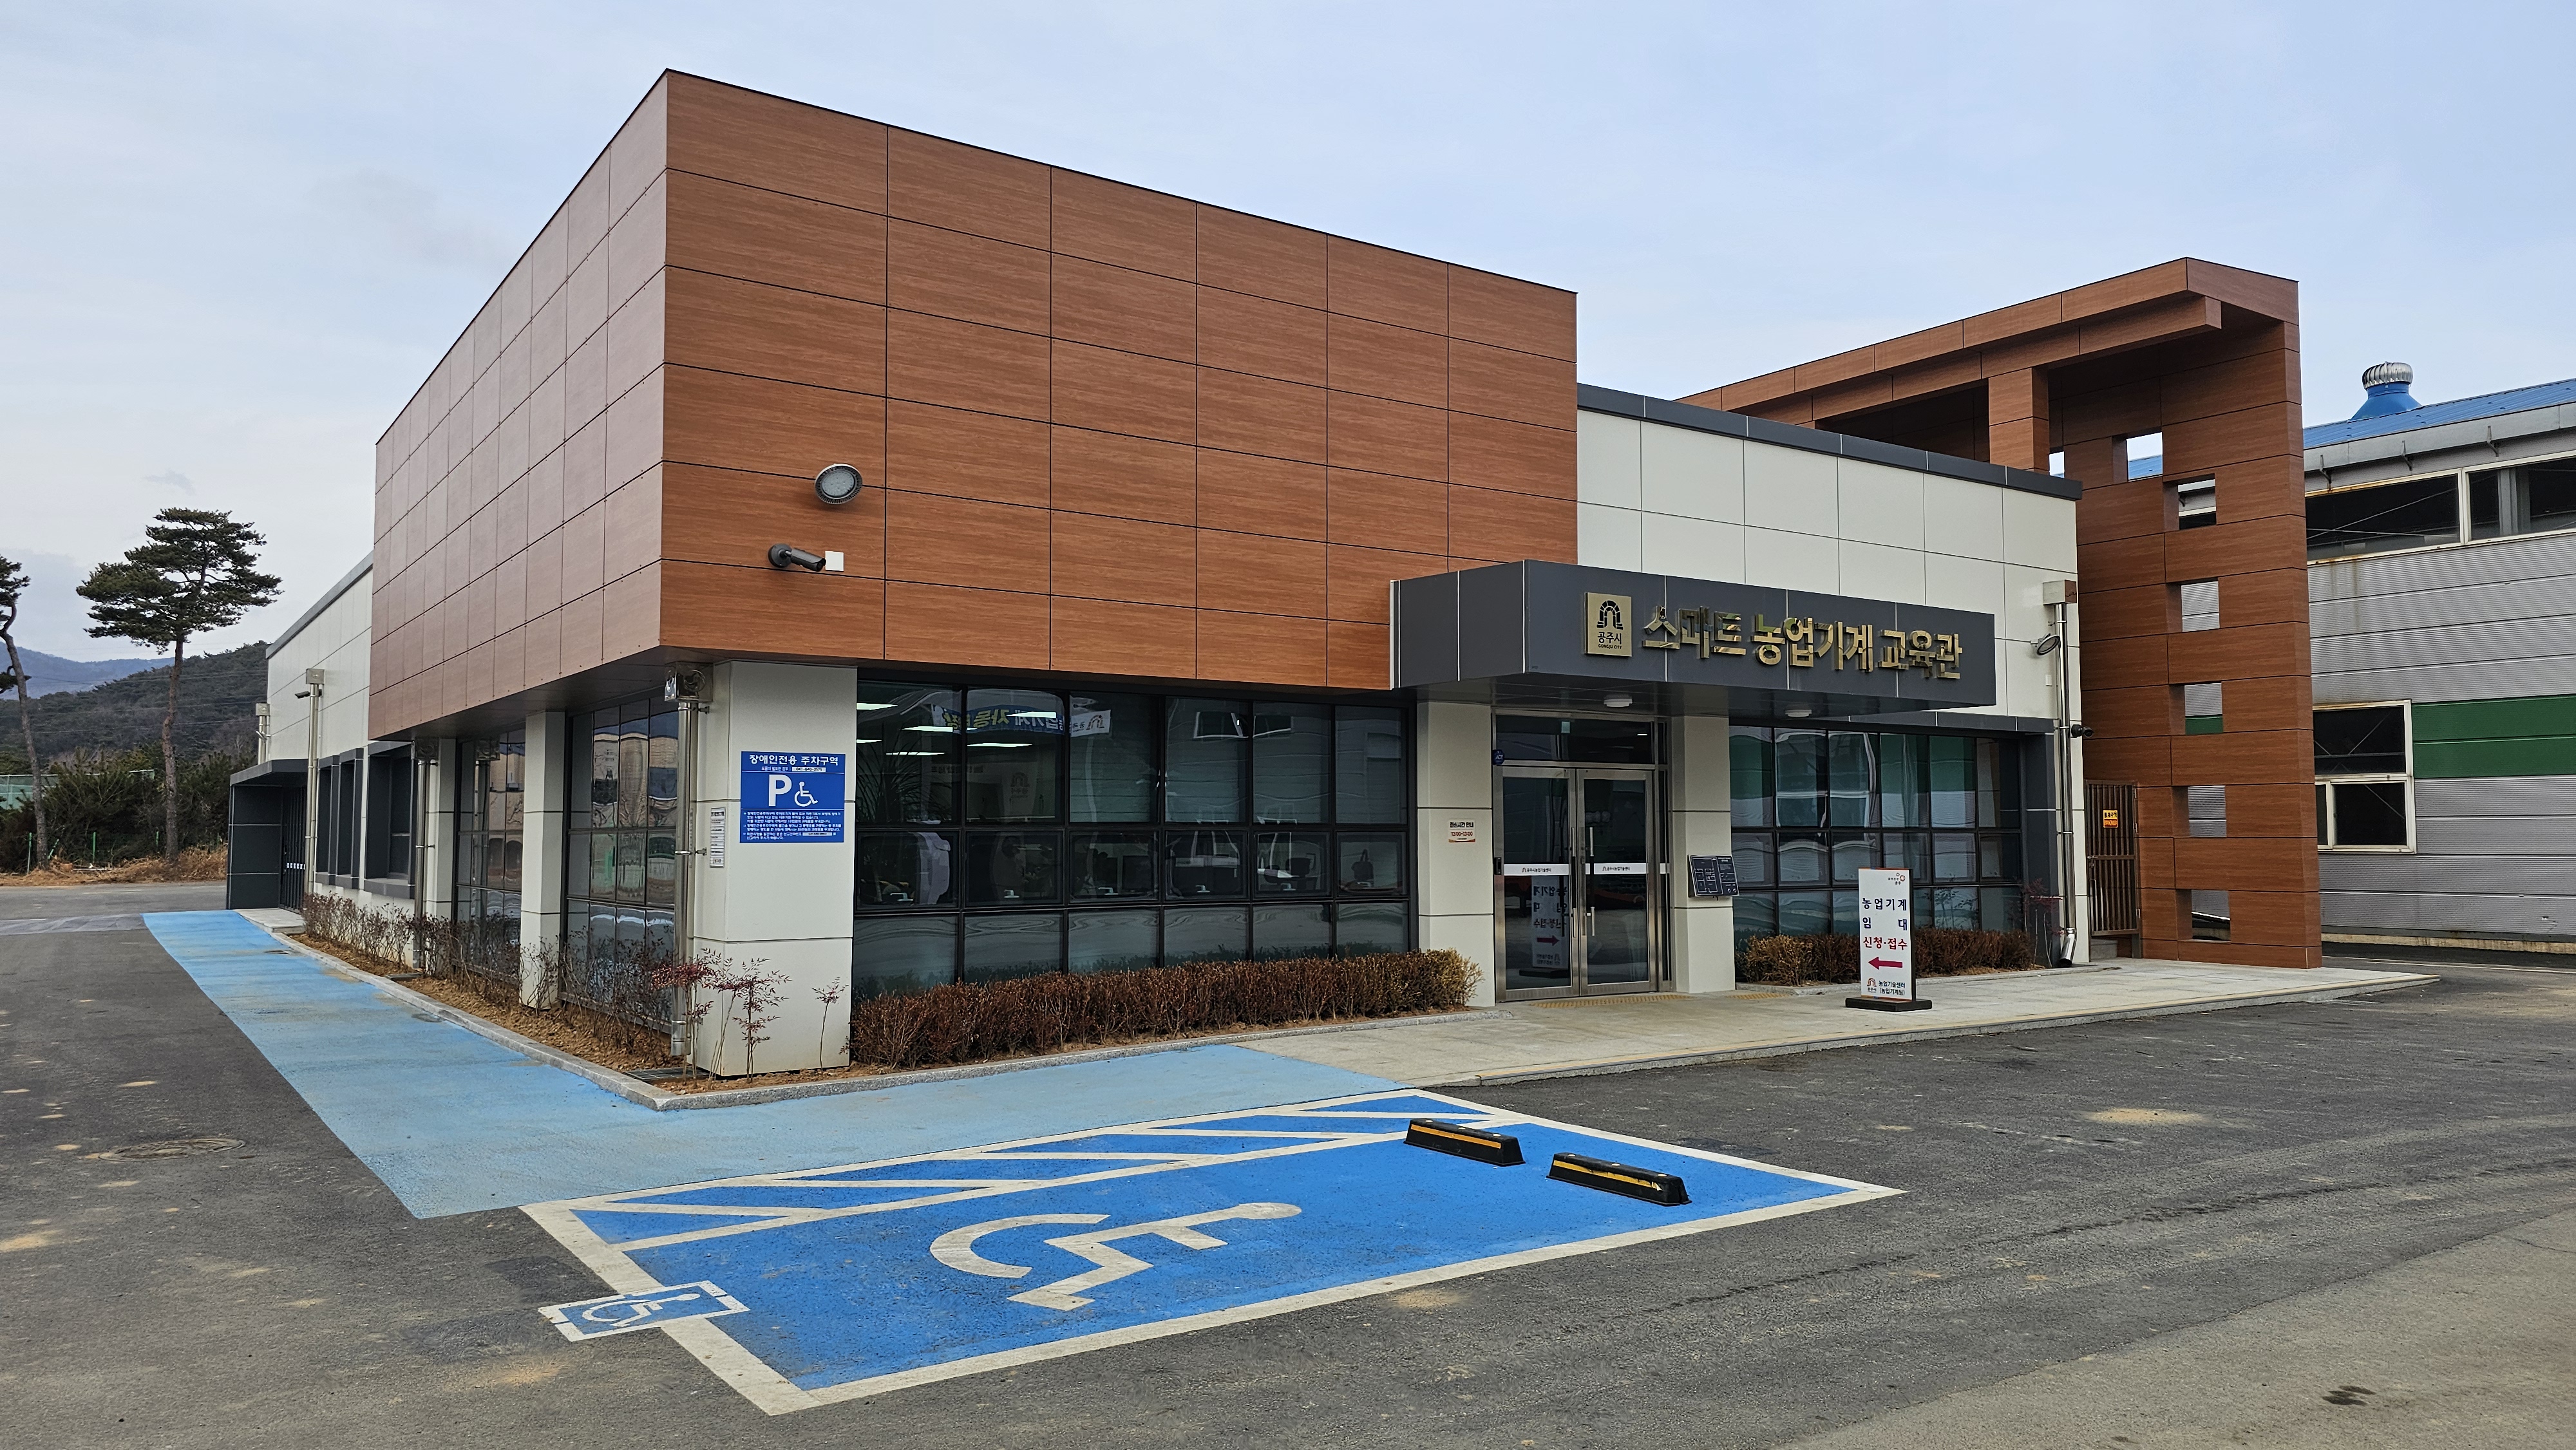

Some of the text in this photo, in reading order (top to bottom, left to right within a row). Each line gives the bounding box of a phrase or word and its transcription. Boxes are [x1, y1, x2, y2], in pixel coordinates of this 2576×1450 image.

[1597, 631, 1622, 645] 공주시
[1642, 605, 1962, 679] 스마트 농업기계 교육관
[749, 754, 838, 766] 장애인전용 주차구역
[768, 774, 792, 807] P
[1862, 898, 1907, 911] 농업기계
[1862, 917, 1908, 931] 임 대
[1863, 936, 1908, 950] 신청·접수
[1878, 980, 1906, 988] 농업기술센터
[1879, 987, 1905, 995] (농업기계팀)
